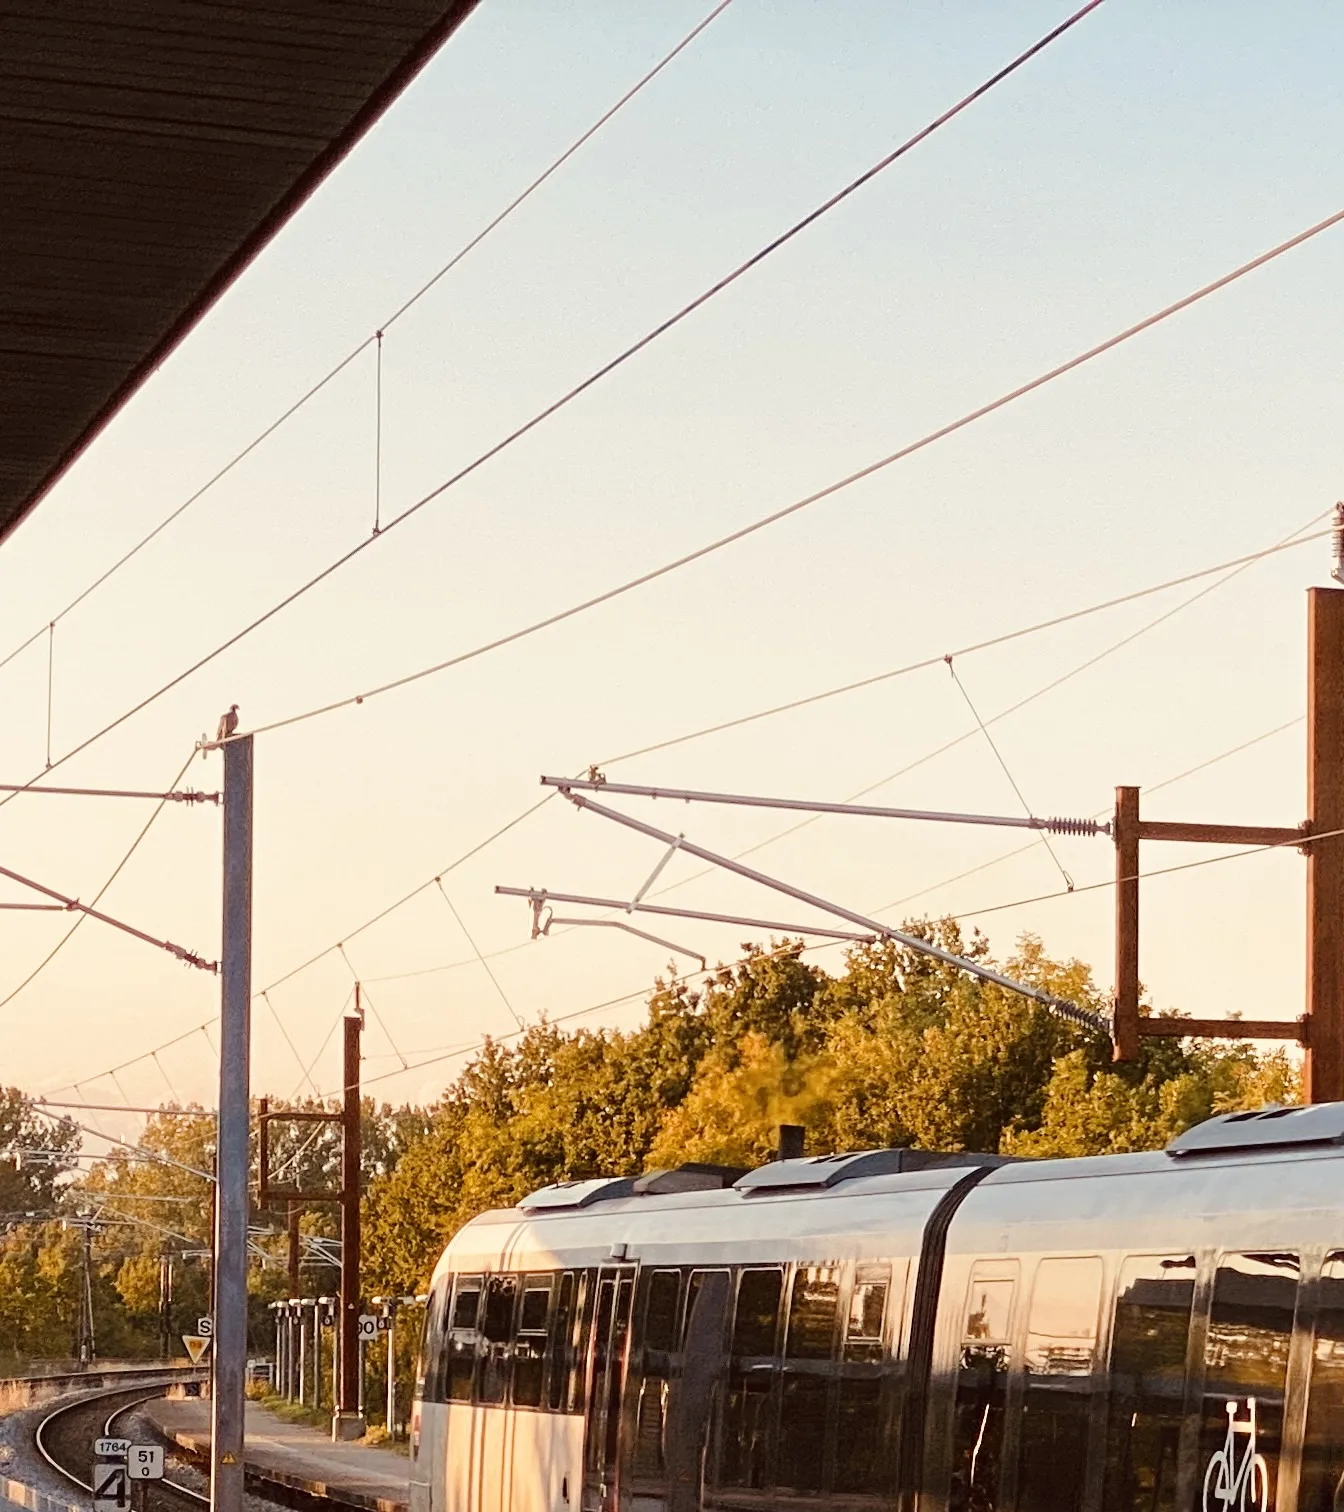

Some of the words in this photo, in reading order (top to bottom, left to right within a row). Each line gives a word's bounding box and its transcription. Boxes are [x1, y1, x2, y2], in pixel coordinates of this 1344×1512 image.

[200, 1320, 211, 1333] S
[100, 1442, 126, 1453] 1764
[138, 1450, 154, 1463] 51
[94, 1468, 126, 1508] 4
